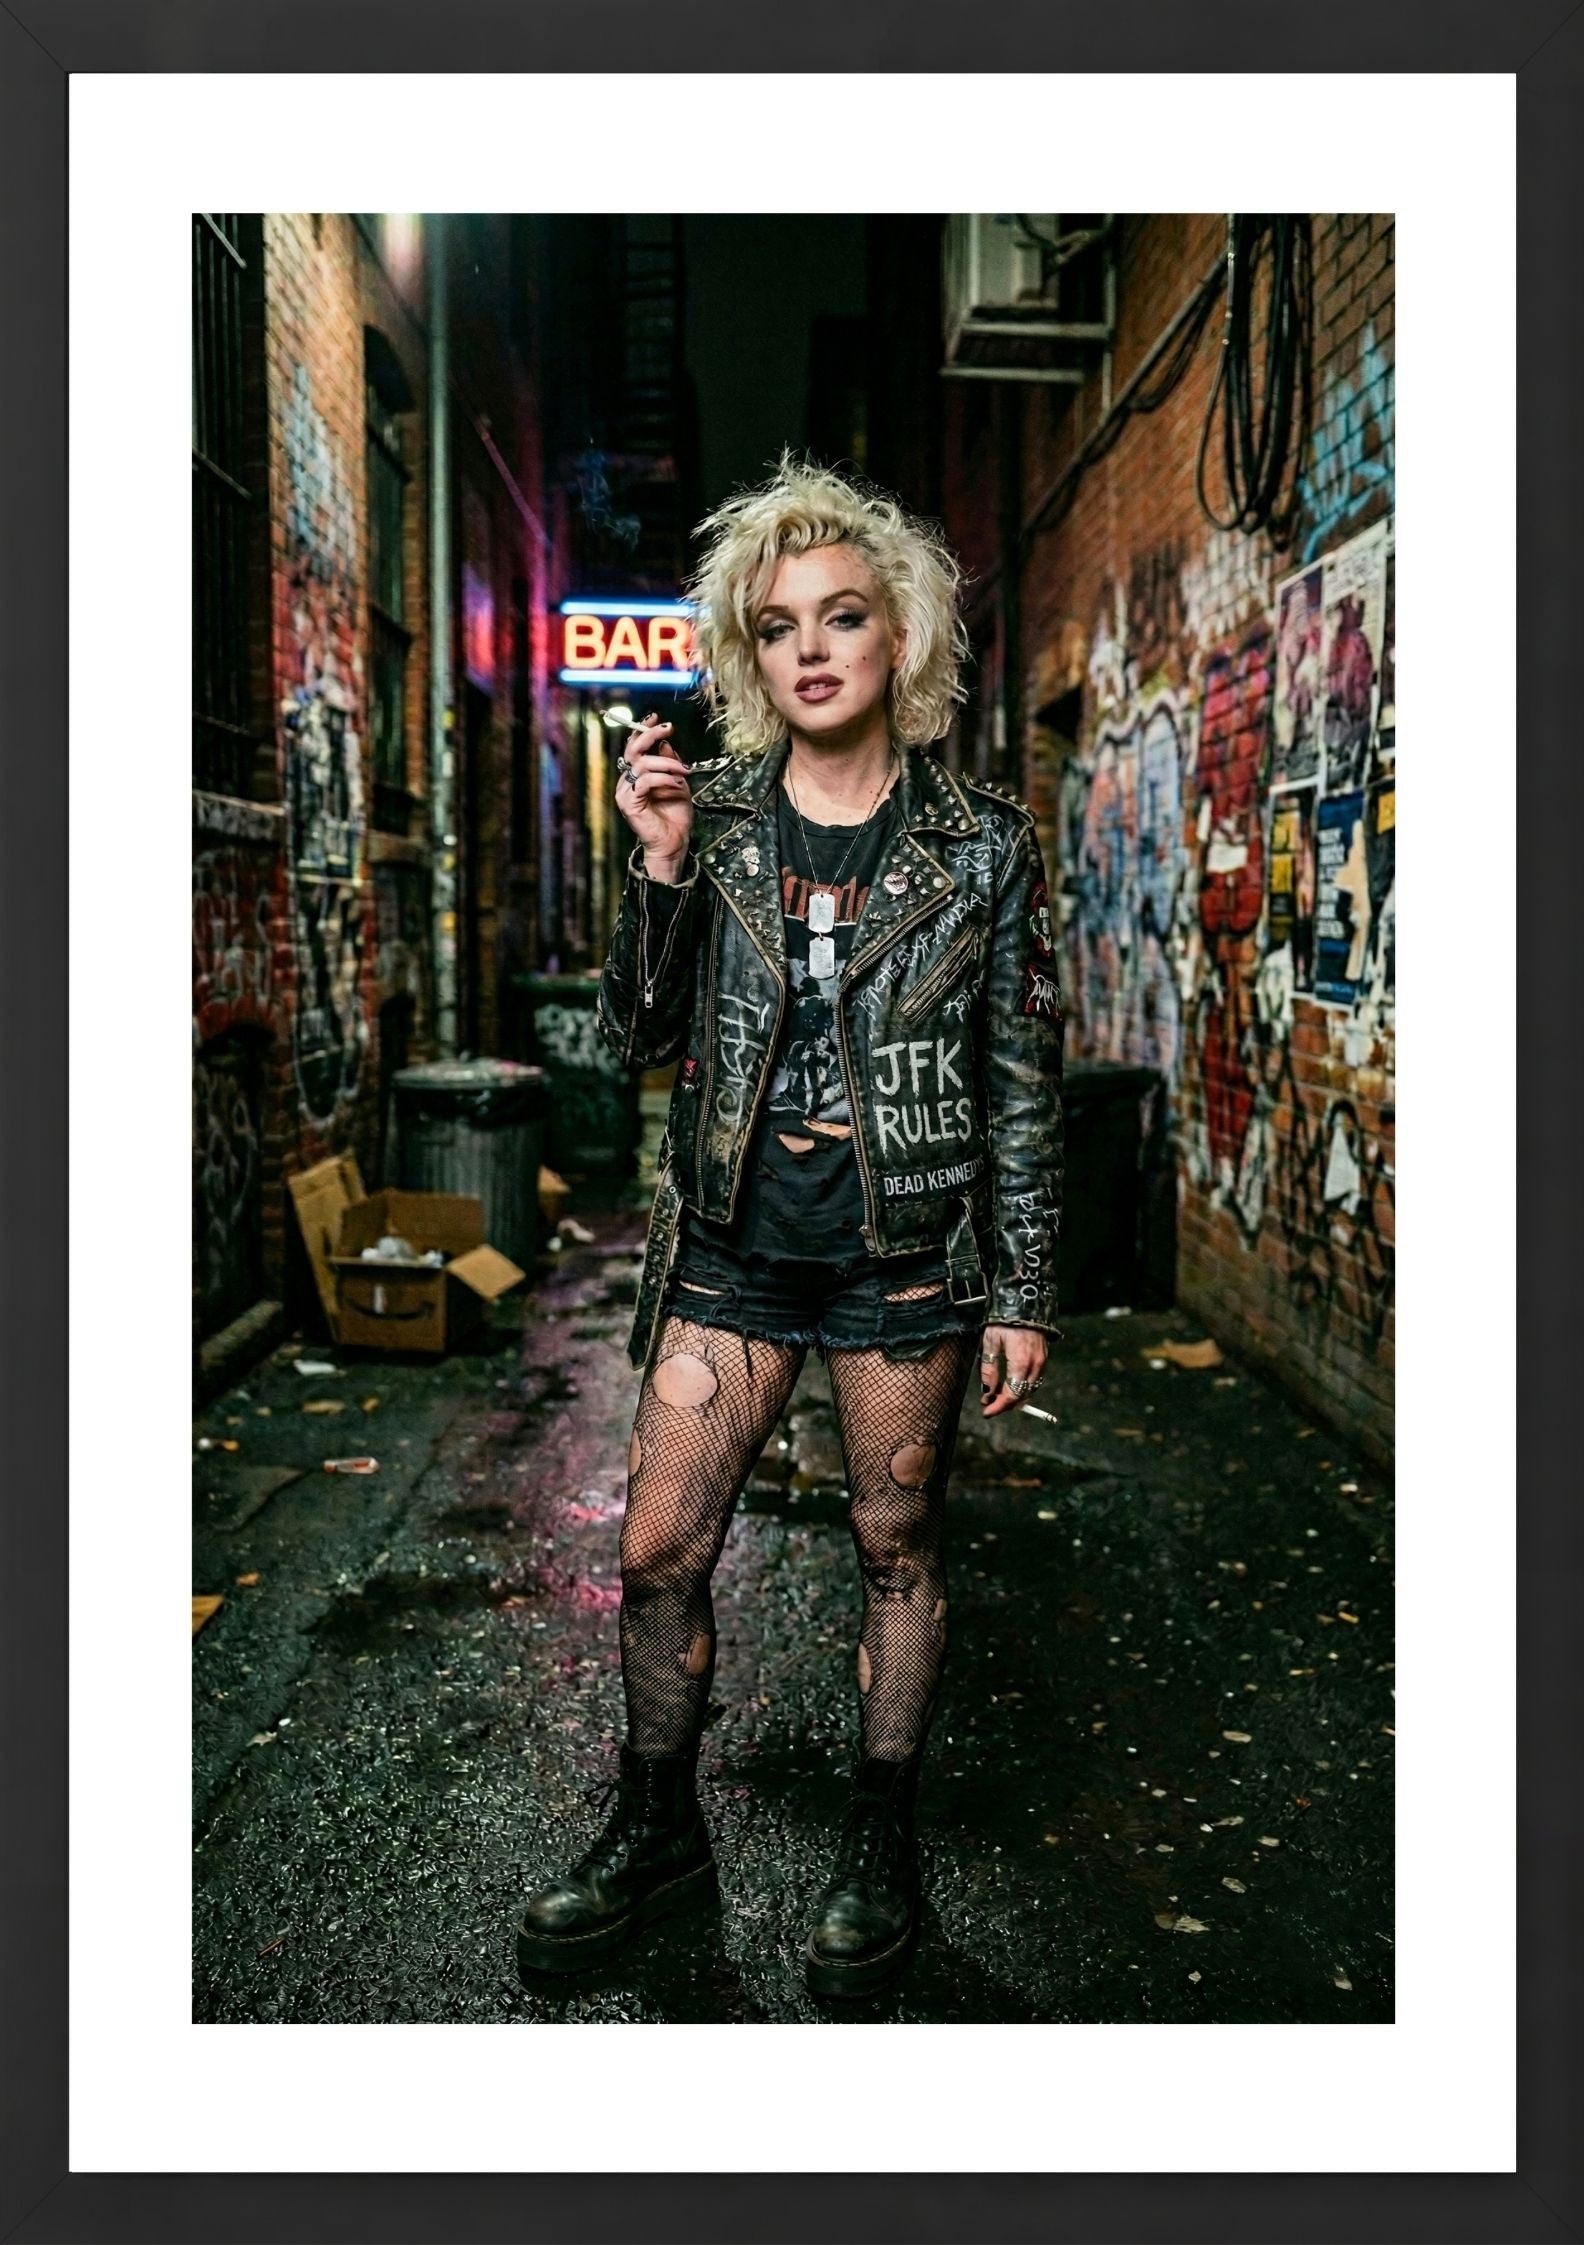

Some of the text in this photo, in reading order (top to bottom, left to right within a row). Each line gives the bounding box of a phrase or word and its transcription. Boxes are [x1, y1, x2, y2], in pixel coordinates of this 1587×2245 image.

[872, 1035, 963, 1098] JFK
[875, 1098, 972, 1158] RULES
[884, 1174, 924, 1196] DEAD
